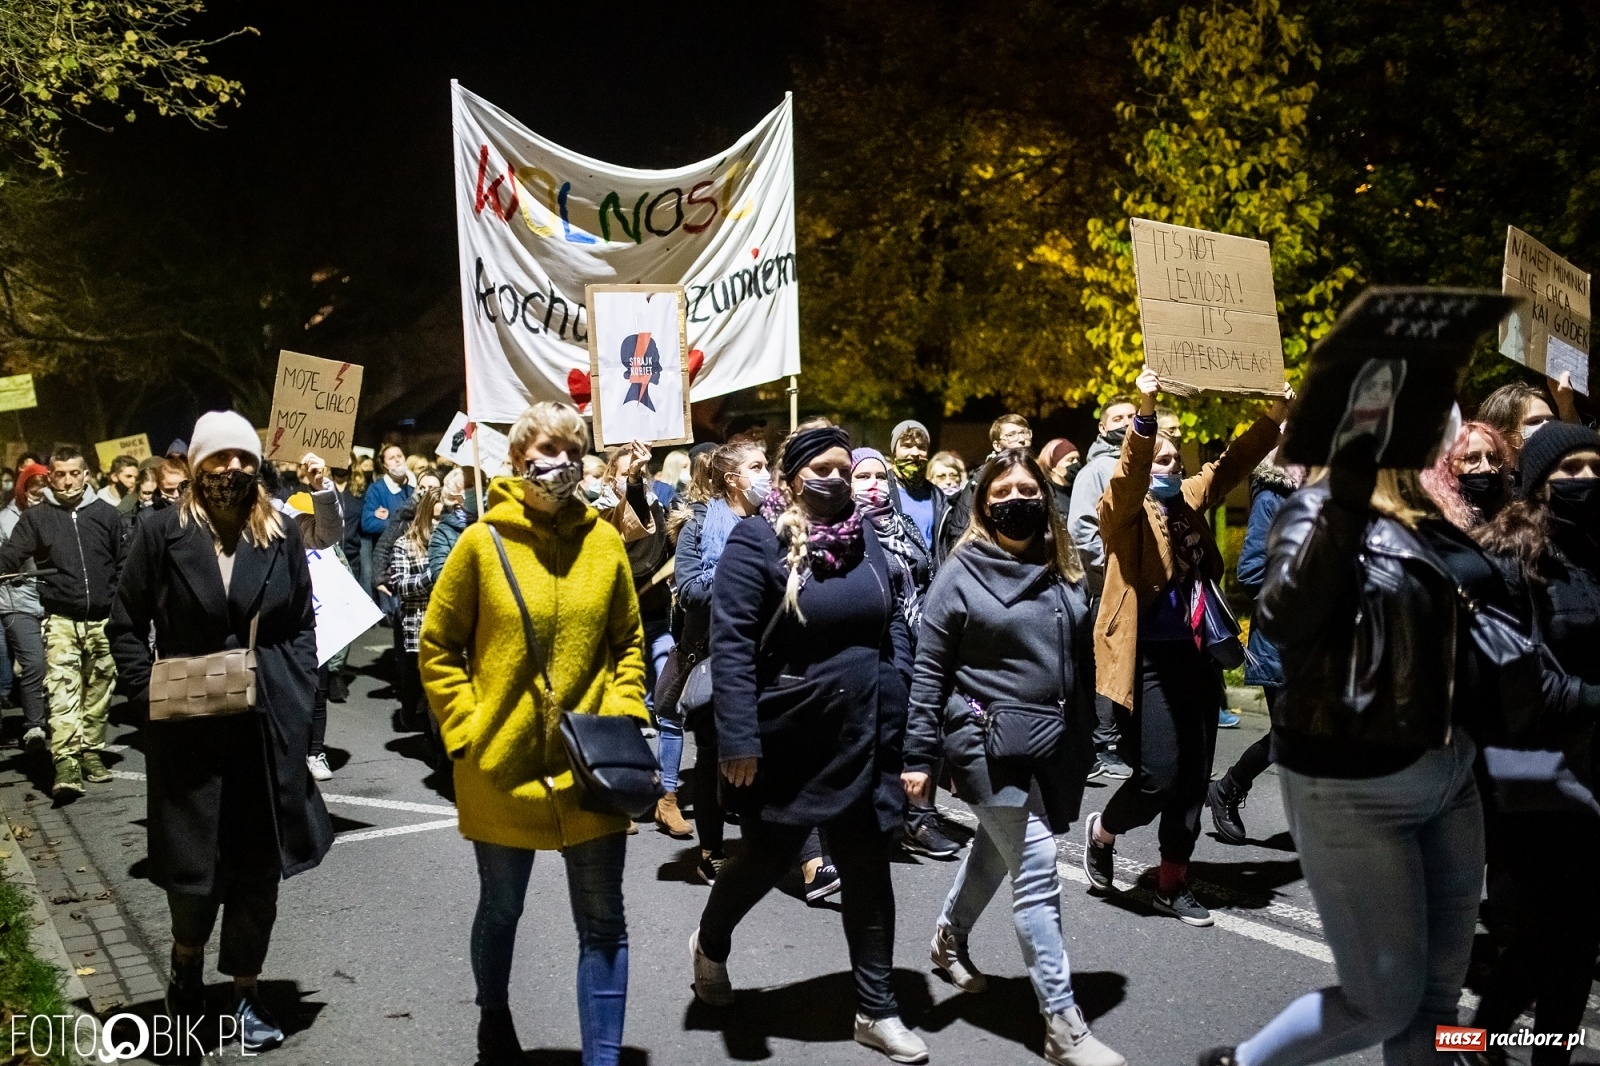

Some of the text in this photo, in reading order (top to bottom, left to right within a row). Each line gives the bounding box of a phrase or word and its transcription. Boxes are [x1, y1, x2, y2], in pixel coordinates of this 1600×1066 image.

[475, 140, 754, 245] WOLNOŚĆ
[1153, 229, 1215, 264] IT'S NOT
[1512, 236, 1551, 274] NAWET
[1166, 268, 1243, 304] LEVIOSA!
[1519, 267, 1572, 319] NIE CHCĄ
[1202, 307, 1233, 336] IT'S
[1553, 313, 1588, 350] GODEK
[629, 356, 653, 366] STRAJK
[630, 366, 653, 376] KOBIET
[315, 391, 356, 414] CIAŁO
